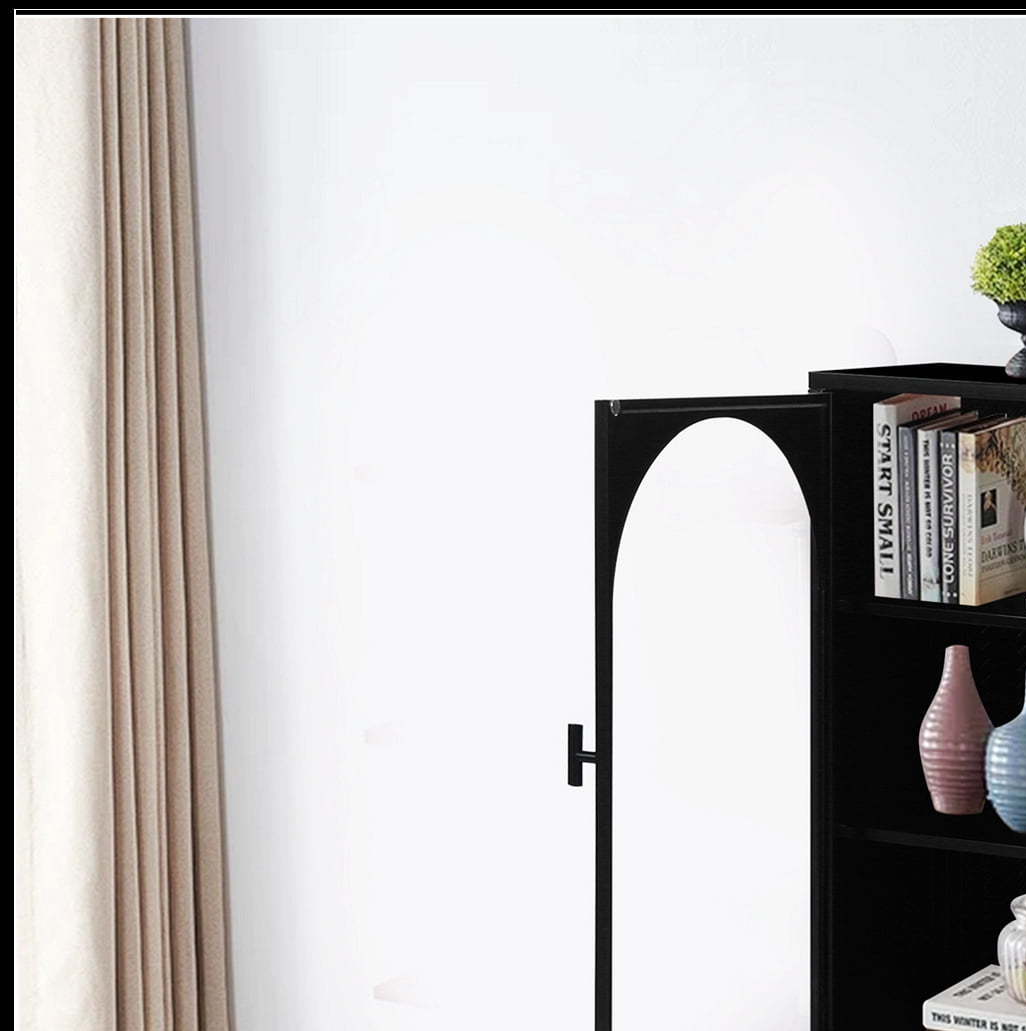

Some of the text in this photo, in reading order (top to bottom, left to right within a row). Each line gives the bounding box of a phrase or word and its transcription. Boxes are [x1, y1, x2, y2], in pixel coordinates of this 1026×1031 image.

[876, 423, 894, 581] START SMALL
[942, 454, 956, 584] LONE SURVIVOR
[931, 1012, 951, 1024] THIS
[953, 1015, 987, 1031] WINTER
[990, 1020, 999, 1031] IS
